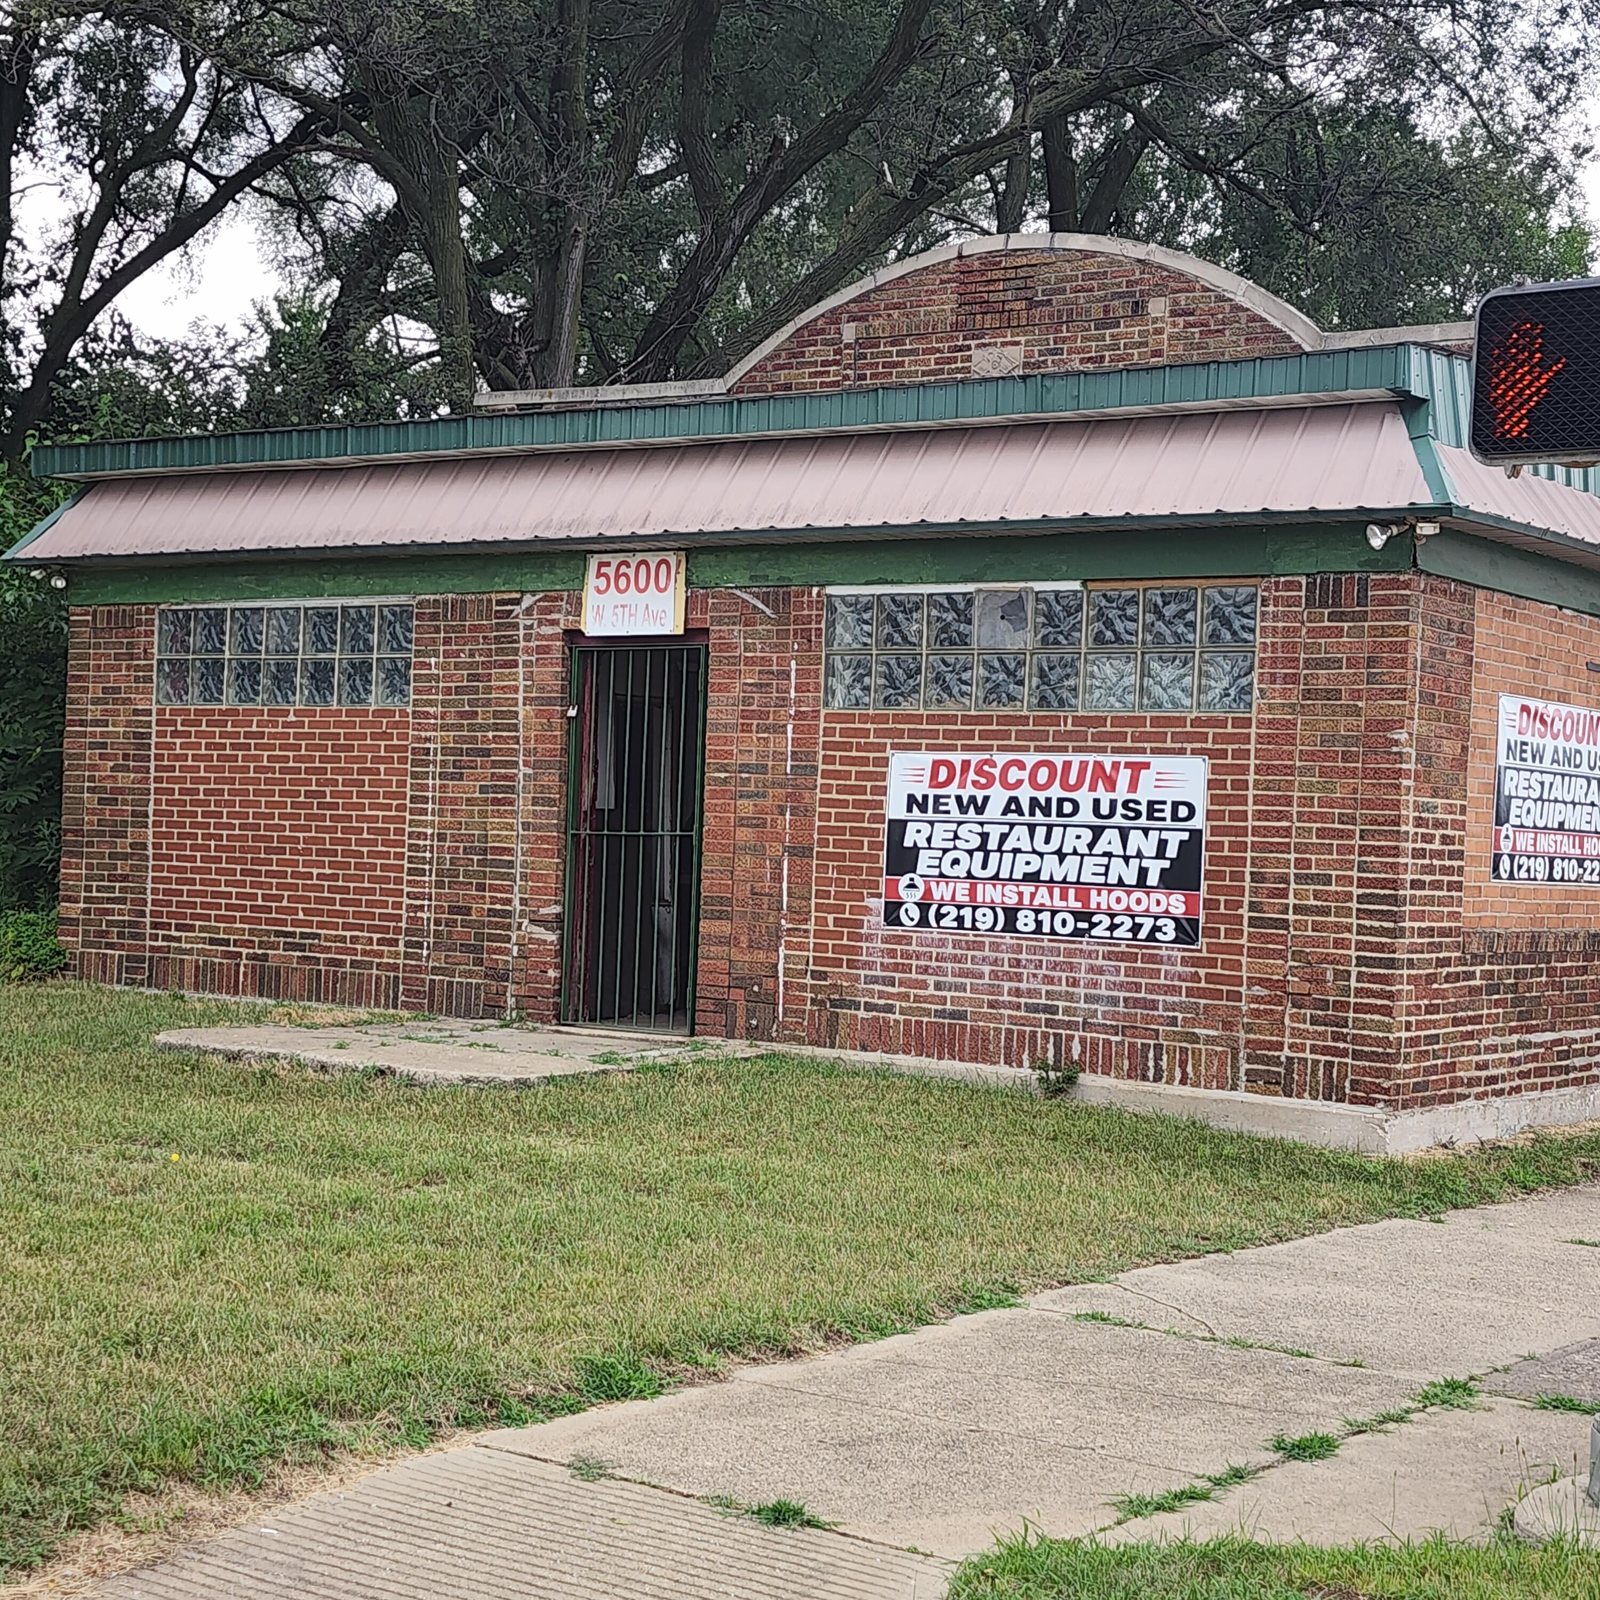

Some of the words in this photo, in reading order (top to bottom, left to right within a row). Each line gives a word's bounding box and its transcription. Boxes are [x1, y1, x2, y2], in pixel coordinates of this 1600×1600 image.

[593, 558, 672, 595] 5600
[641, 603, 668, 627] Ave
[1506, 738, 1547, 766] NEW
[1550, 744, 1583, 769] AND
[1587, 750, 1600, 772] U
[928, 758, 1152, 794] DISCOUNT
[905, 793, 992, 816] NEW
[1000, 795, 1081, 818] AND
[1092, 798, 1197, 823] USED
[903, 821, 1190, 859] RESTAURANT
[1515, 831, 1535, 852] WE
[1536, 832, 1581, 855] INSTALL
[916, 849, 1172, 887] EQUIPMENT
[1513, 855, 1550, 881] (219)
[929, 881, 971, 901] WE
[976, 884, 1083, 909] INSTALL
[1090, 890, 1187, 915] HOODS
[927, 903, 1006, 933] (219)
[1015, 909, 1177, 942] 810-2273
